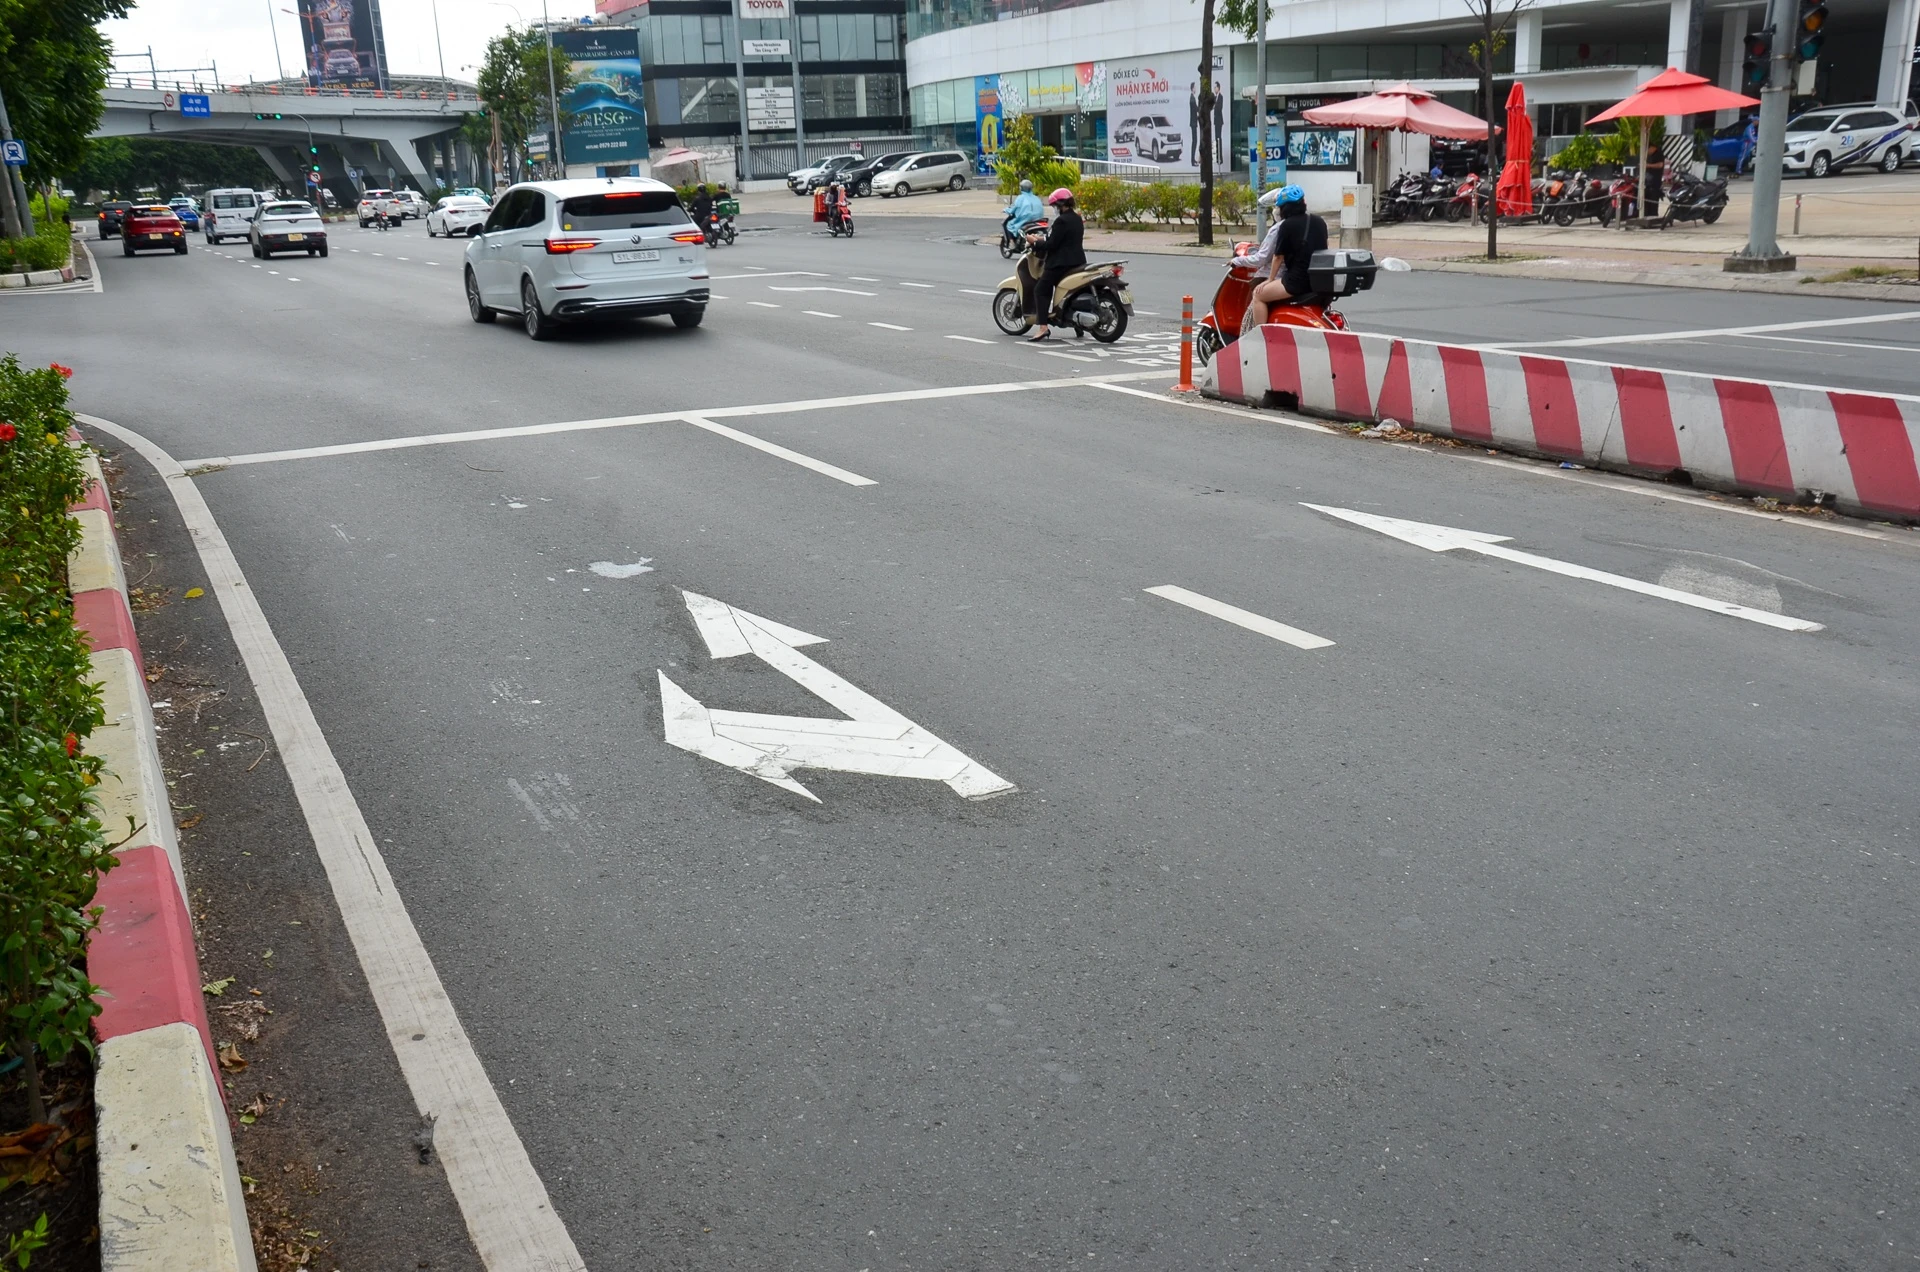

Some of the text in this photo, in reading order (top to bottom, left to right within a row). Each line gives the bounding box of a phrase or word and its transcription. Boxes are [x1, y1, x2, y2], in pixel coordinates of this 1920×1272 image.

[747, 0, 784, 9] TOYOTA
[1124, 70, 1131, 78] XE
[1131, 67, 1139, 78] CŨ
[1116, 78, 1169, 98] NHẬN XE MỚI
[1300, 99, 1320, 107] TOYOTA
